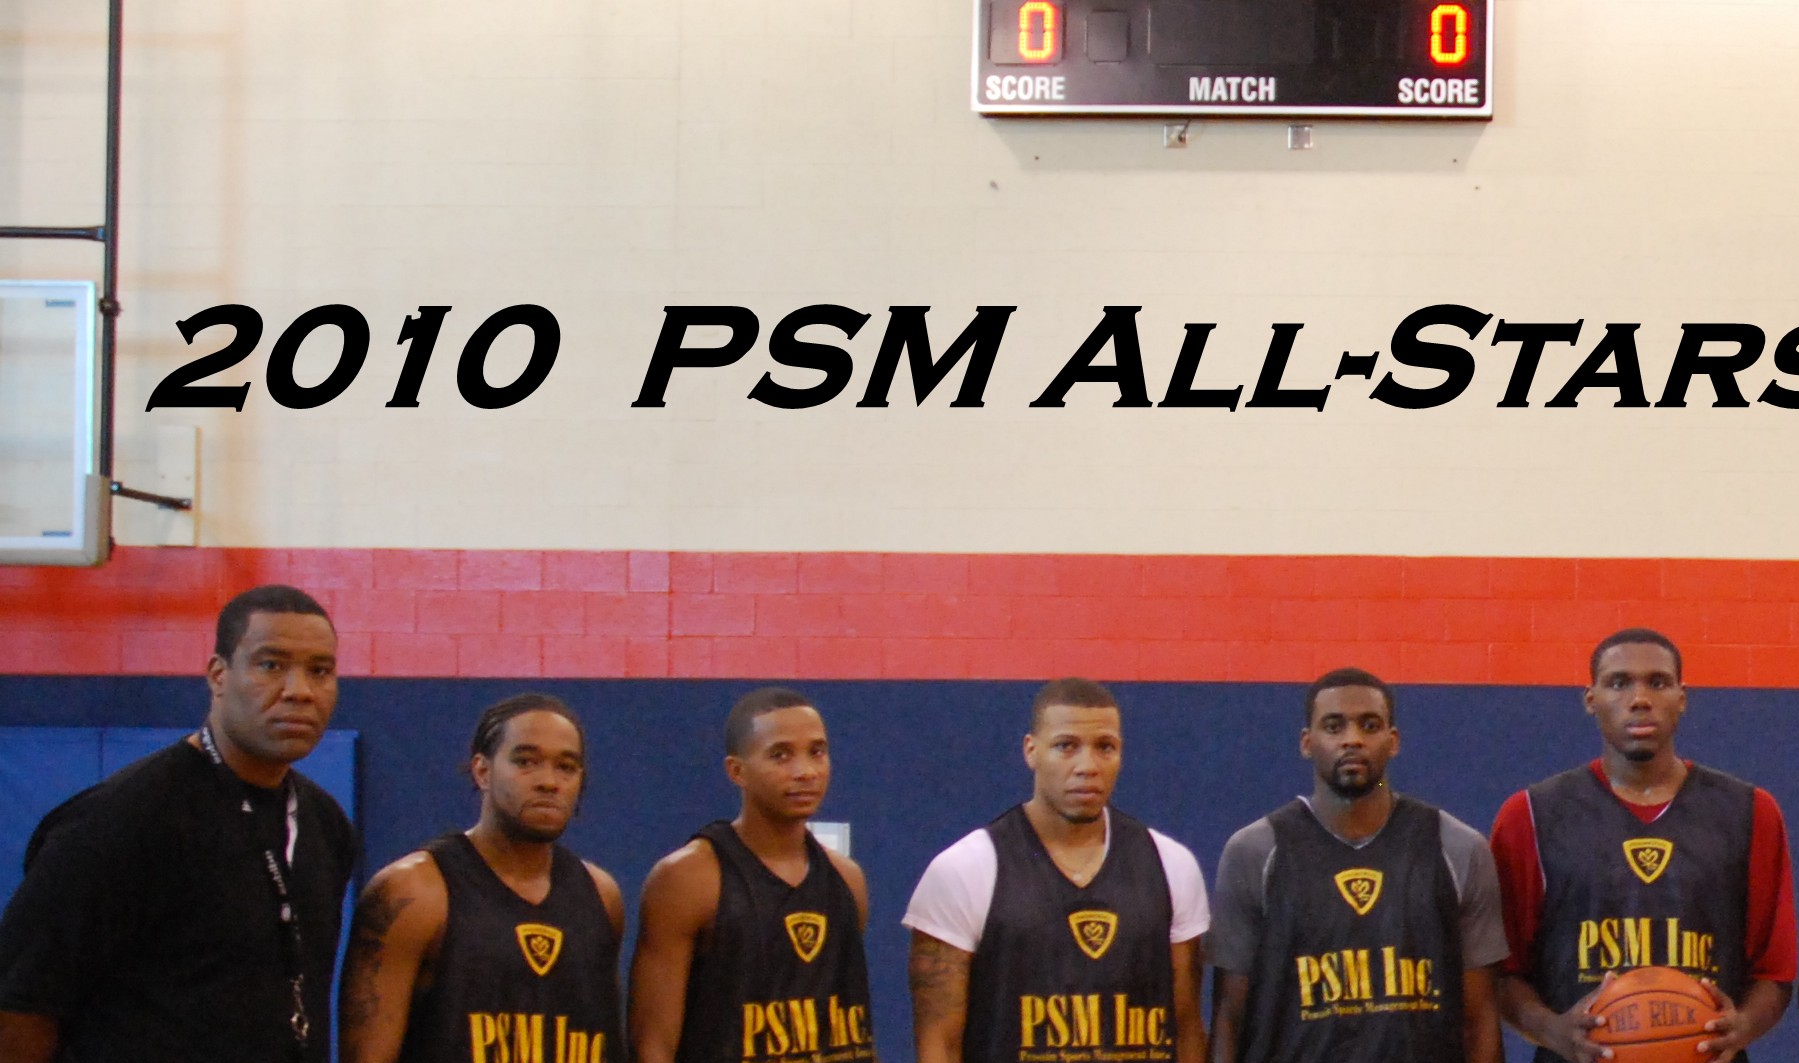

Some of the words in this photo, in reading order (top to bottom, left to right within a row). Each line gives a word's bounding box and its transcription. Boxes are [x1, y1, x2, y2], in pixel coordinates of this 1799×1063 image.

[1017, 0, 1056, 62] 0
[1430, 4, 1467, 64] 0
[985, 76, 1065, 101] SCORE
[1188, 77, 1276, 102] MATCH
[1397, 78, 1478, 104] SCORE
[1578, 917, 1651, 969] PSM
[1666, 918, 1718, 973] Inc.
[1296, 948, 1373, 1007] PSM
[1381, 946, 1440, 997] Inc.
[742, 998, 819, 1057] PSM
[1019, 994, 1101, 1048] PSM
[1113, 994, 1173, 1046] Inc.
[1648, 999, 1697, 1028] ROCK
